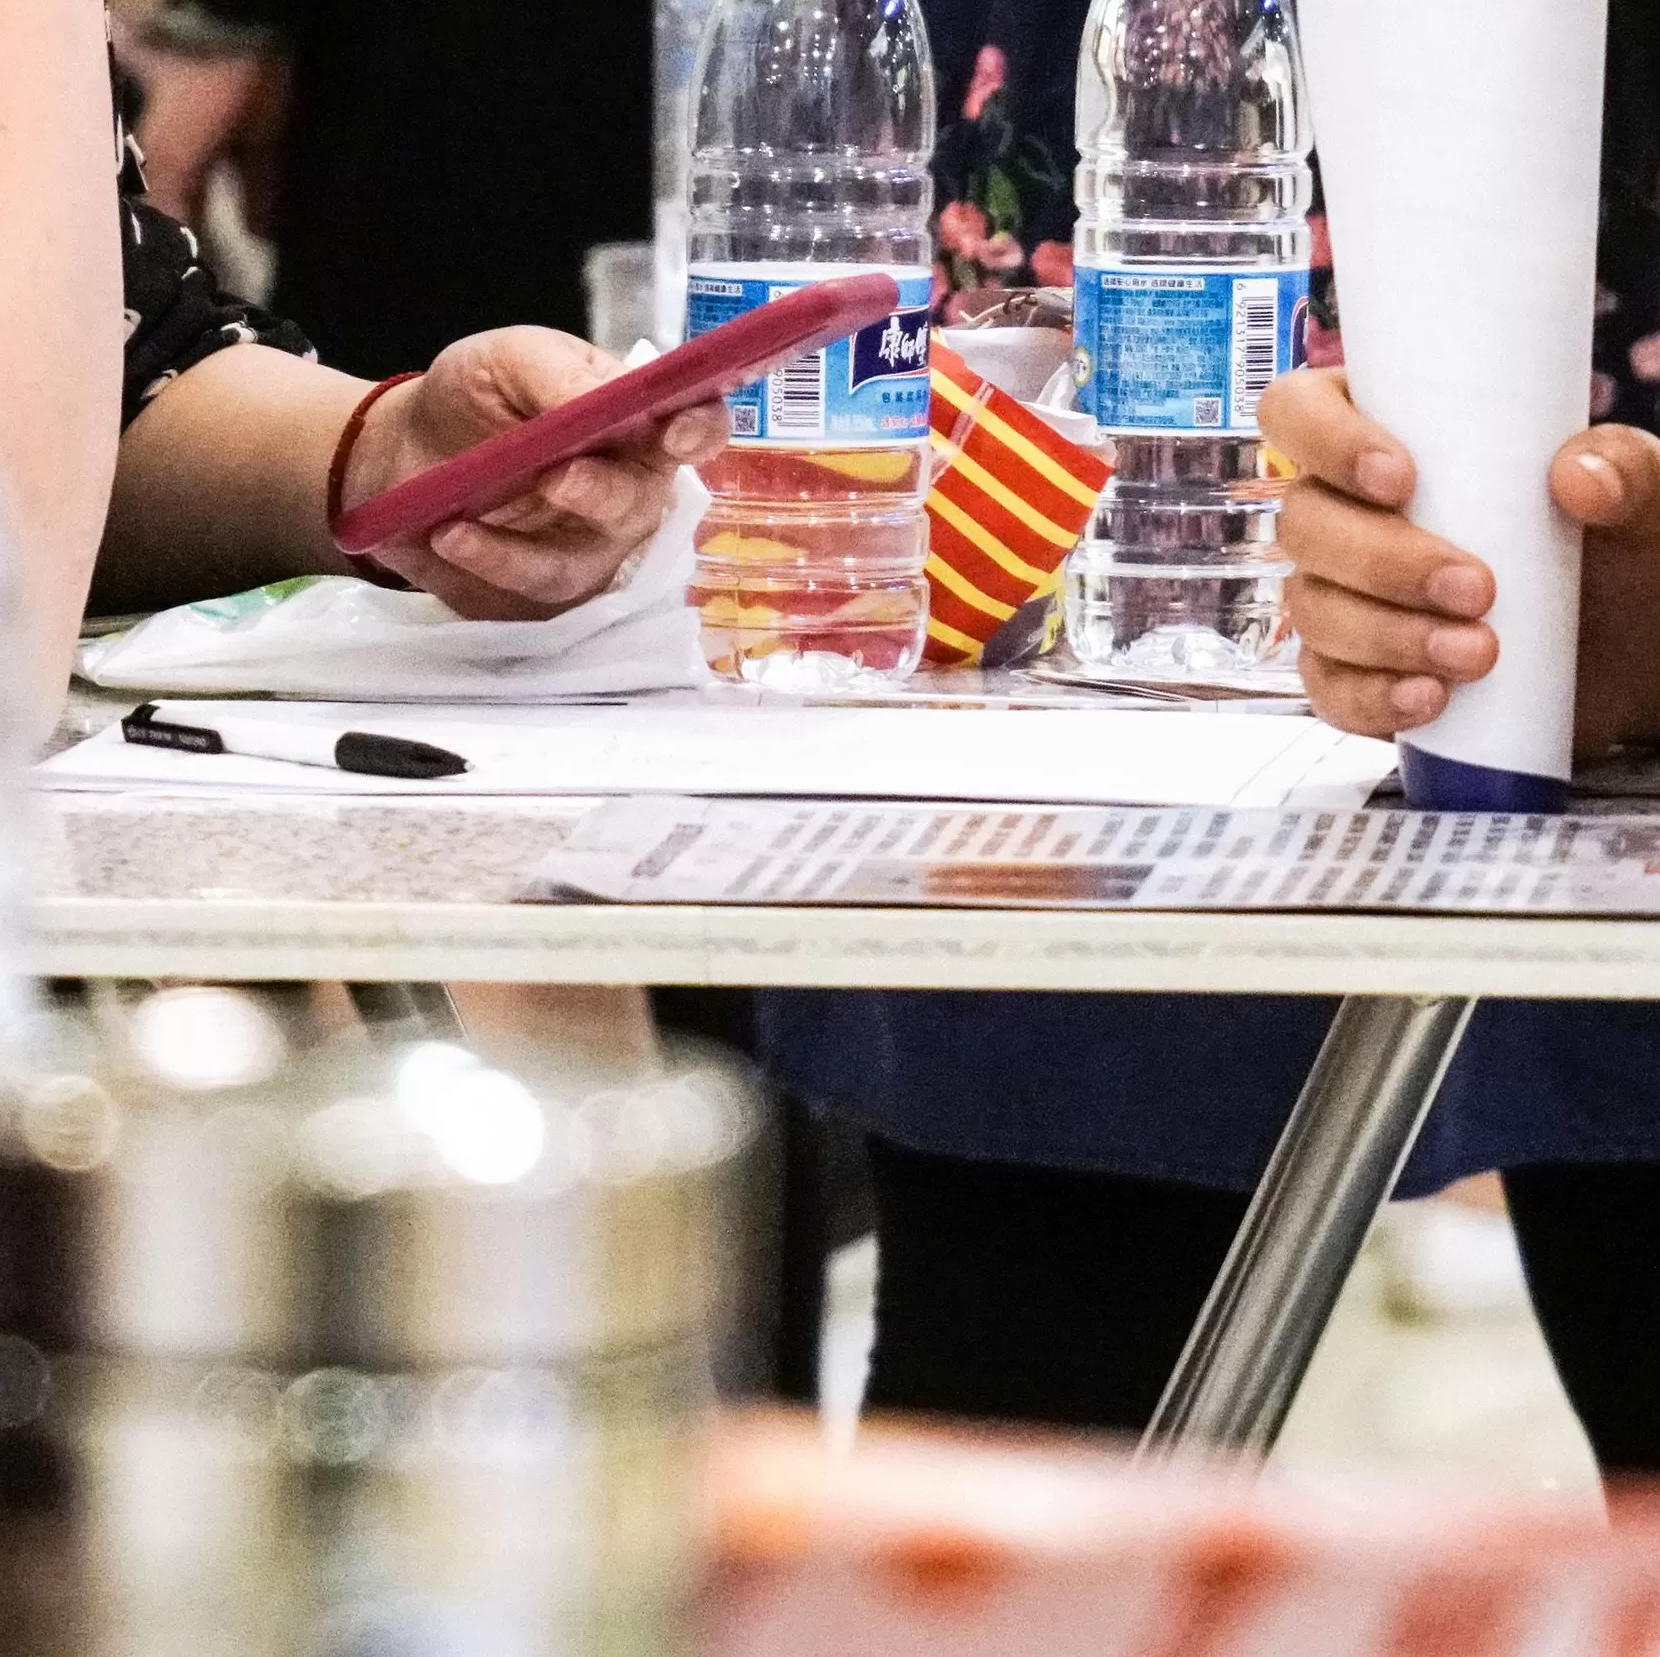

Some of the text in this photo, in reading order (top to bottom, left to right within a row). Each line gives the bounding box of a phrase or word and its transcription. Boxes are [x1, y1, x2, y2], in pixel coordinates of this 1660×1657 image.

[1234, 283, 1247, 412] 6 921317 905038
[772, 370, 783, 421] 905038
